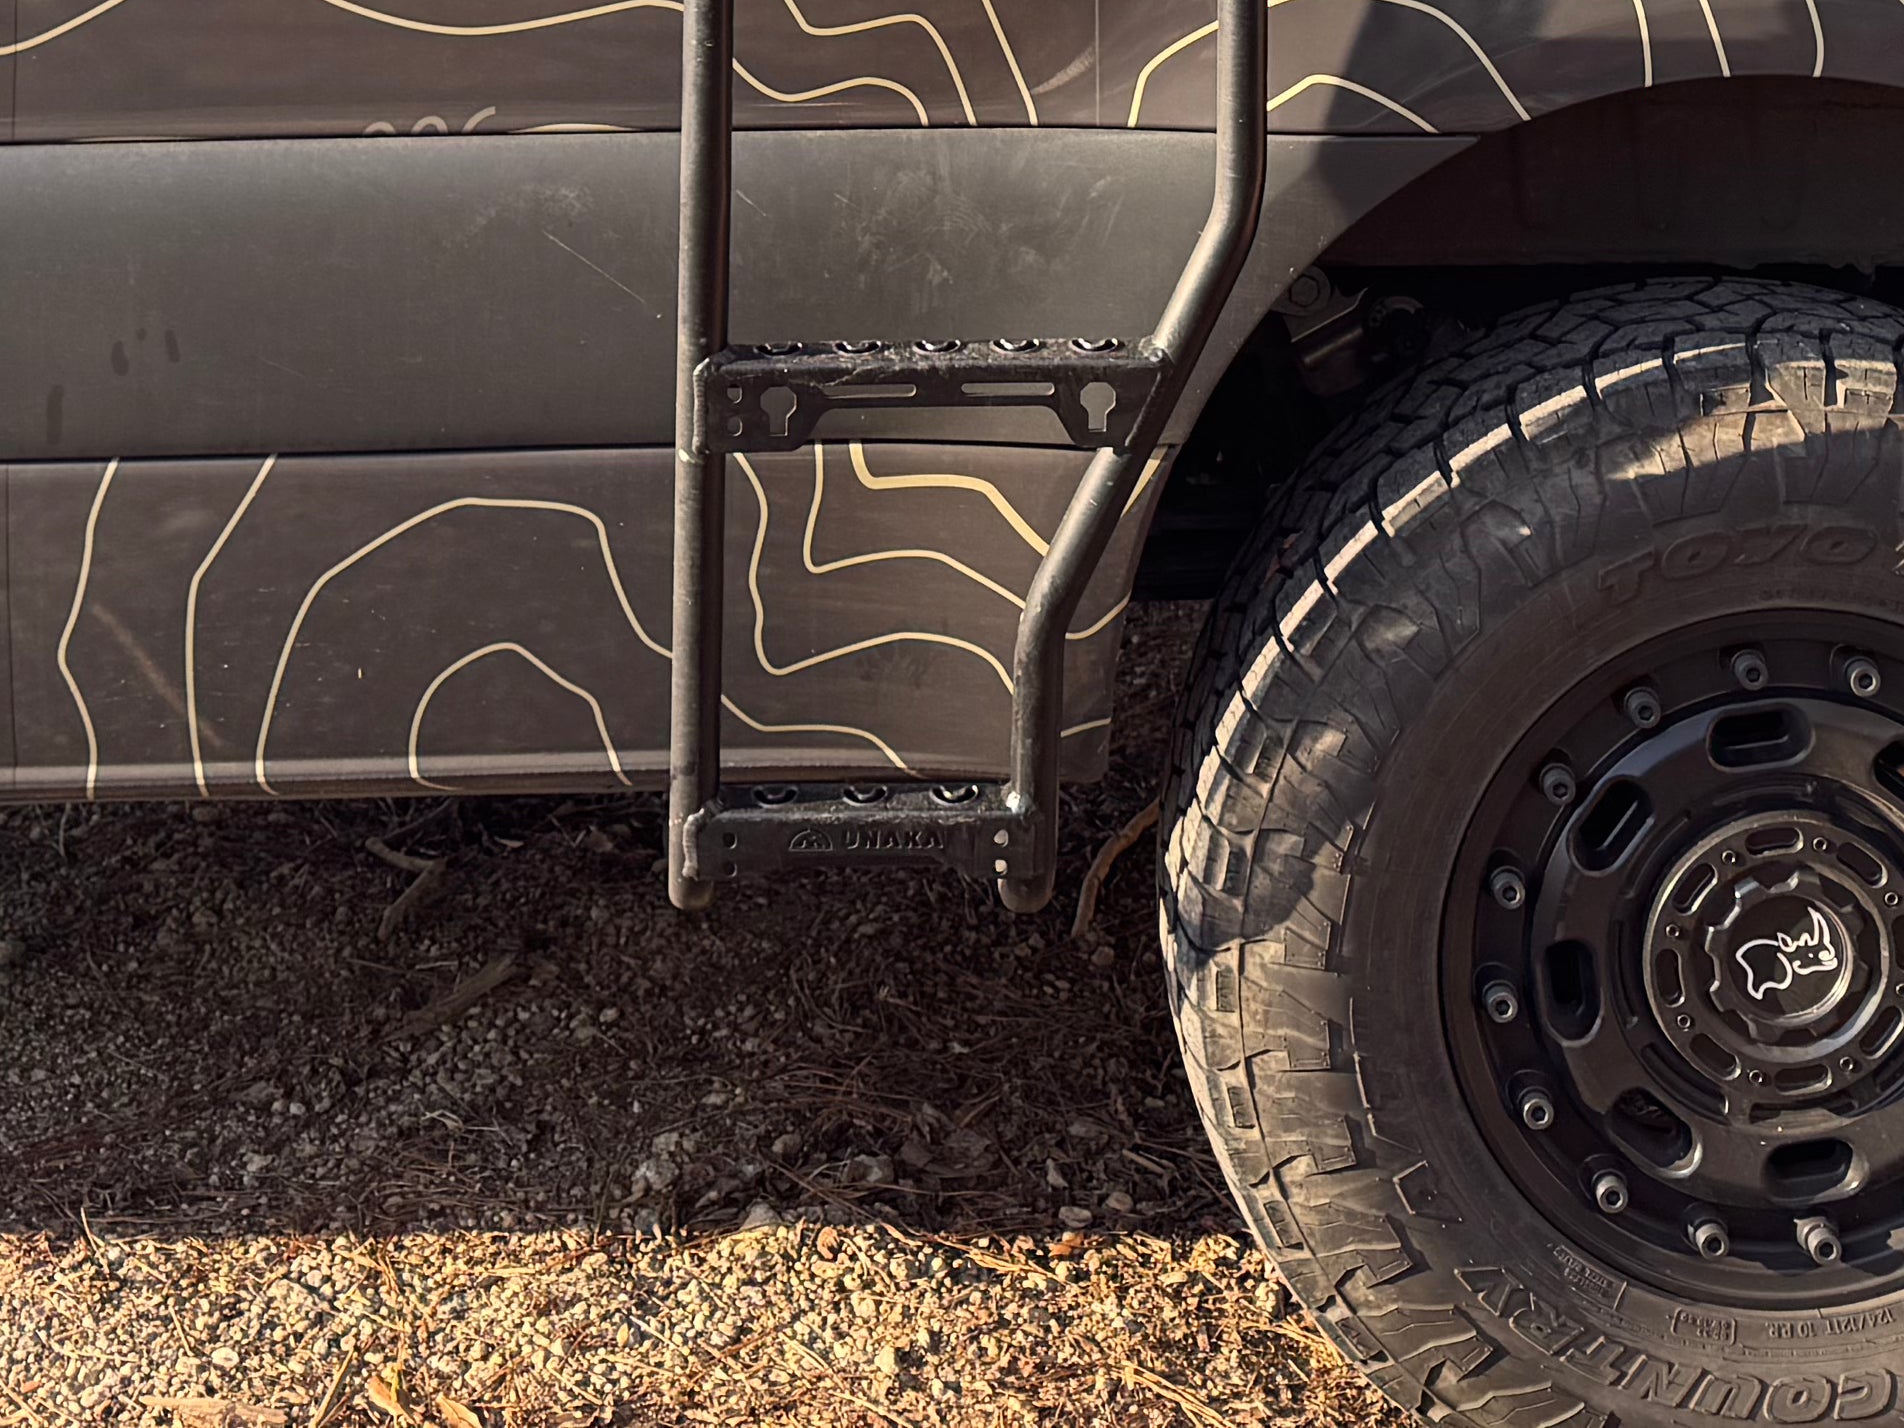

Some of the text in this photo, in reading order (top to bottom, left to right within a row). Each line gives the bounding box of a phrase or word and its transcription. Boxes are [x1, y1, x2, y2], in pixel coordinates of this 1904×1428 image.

[1598, 522, 1878, 606] TOYO
[844, 829, 944, 850] UNAKA
[1454, 1266, 1893, 1423] COUNTRY
